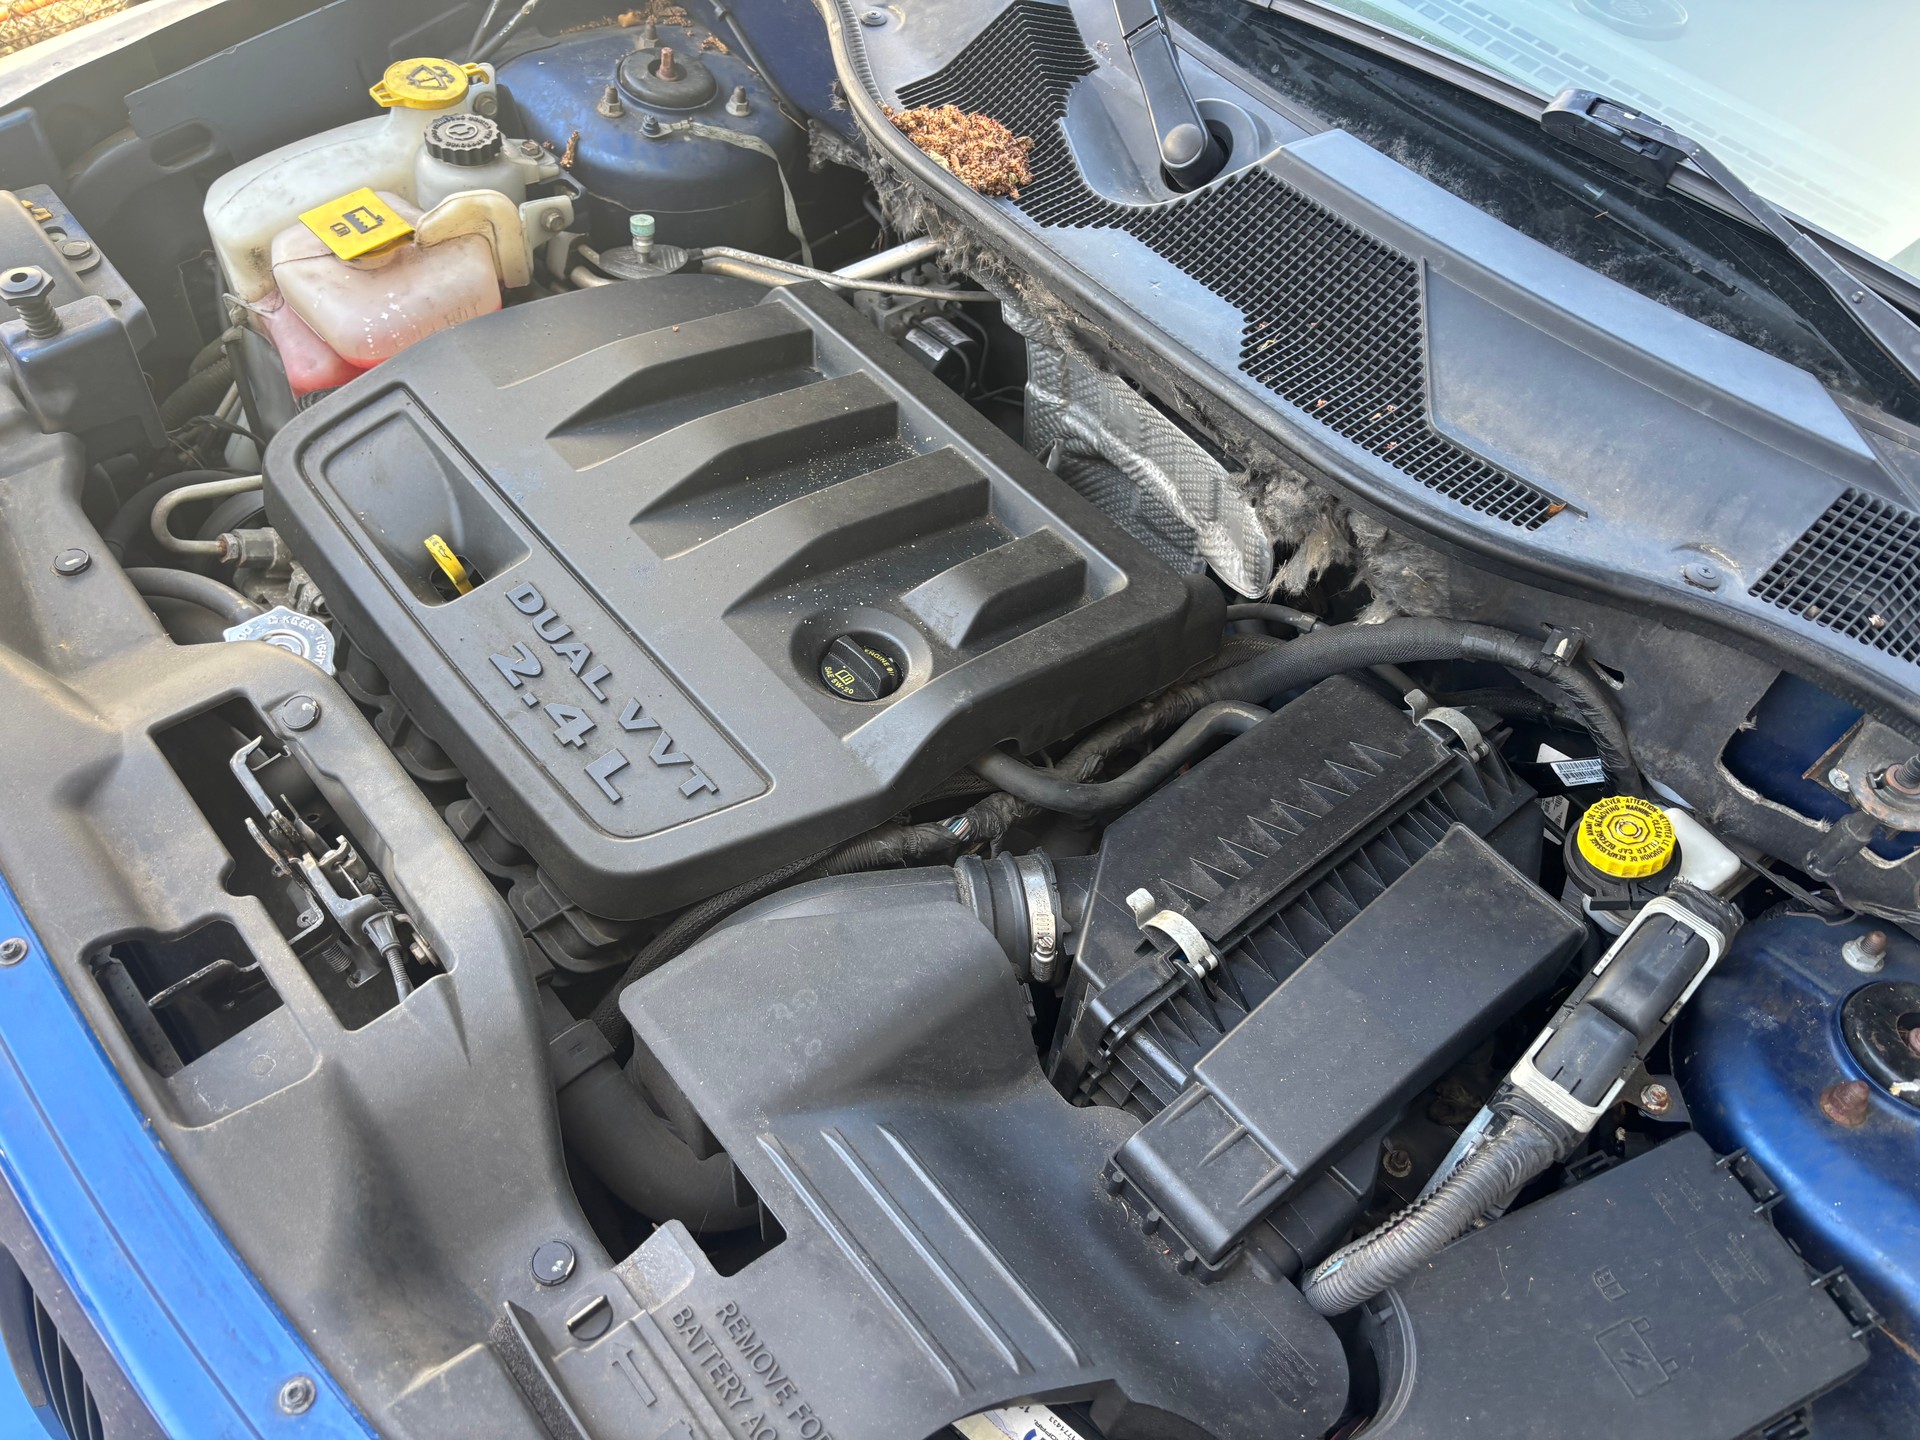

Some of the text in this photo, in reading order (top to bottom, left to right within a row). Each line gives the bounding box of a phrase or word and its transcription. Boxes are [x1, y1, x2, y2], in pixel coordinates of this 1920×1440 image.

[282, 615, 328, 665] KEEP TIGHT
[864, 648, 891, 667] ENGINE
[504, 581, 720, 799] DUAL VVT
[824, 666, 854, 695] SAE 5W-20
[488, 640, 631, 805] 2.4 L
[1594, 798, 1621, 814] L'ENLEVER
[1594, 805, 1620, 829] REMOVING
[1585, 820, 1594, 837] AVANT
[1651, 819, 1661, 838] CLEAN
[1659, 813, 1672, 839] NETTOYER
[1590, 837, 1627, 861] REMPLISSAGE
[1594, 830, 1616, 849] BEFORE
[1637, 838, 1660, 854] FILLER
[1661, 839, 1671, 847] LE
[1640, 847, 1666, 861] BOUCHON
[672, 1304, 753, 1410] BATTERY
[715, 1300, 798, 1407] REMOVE
